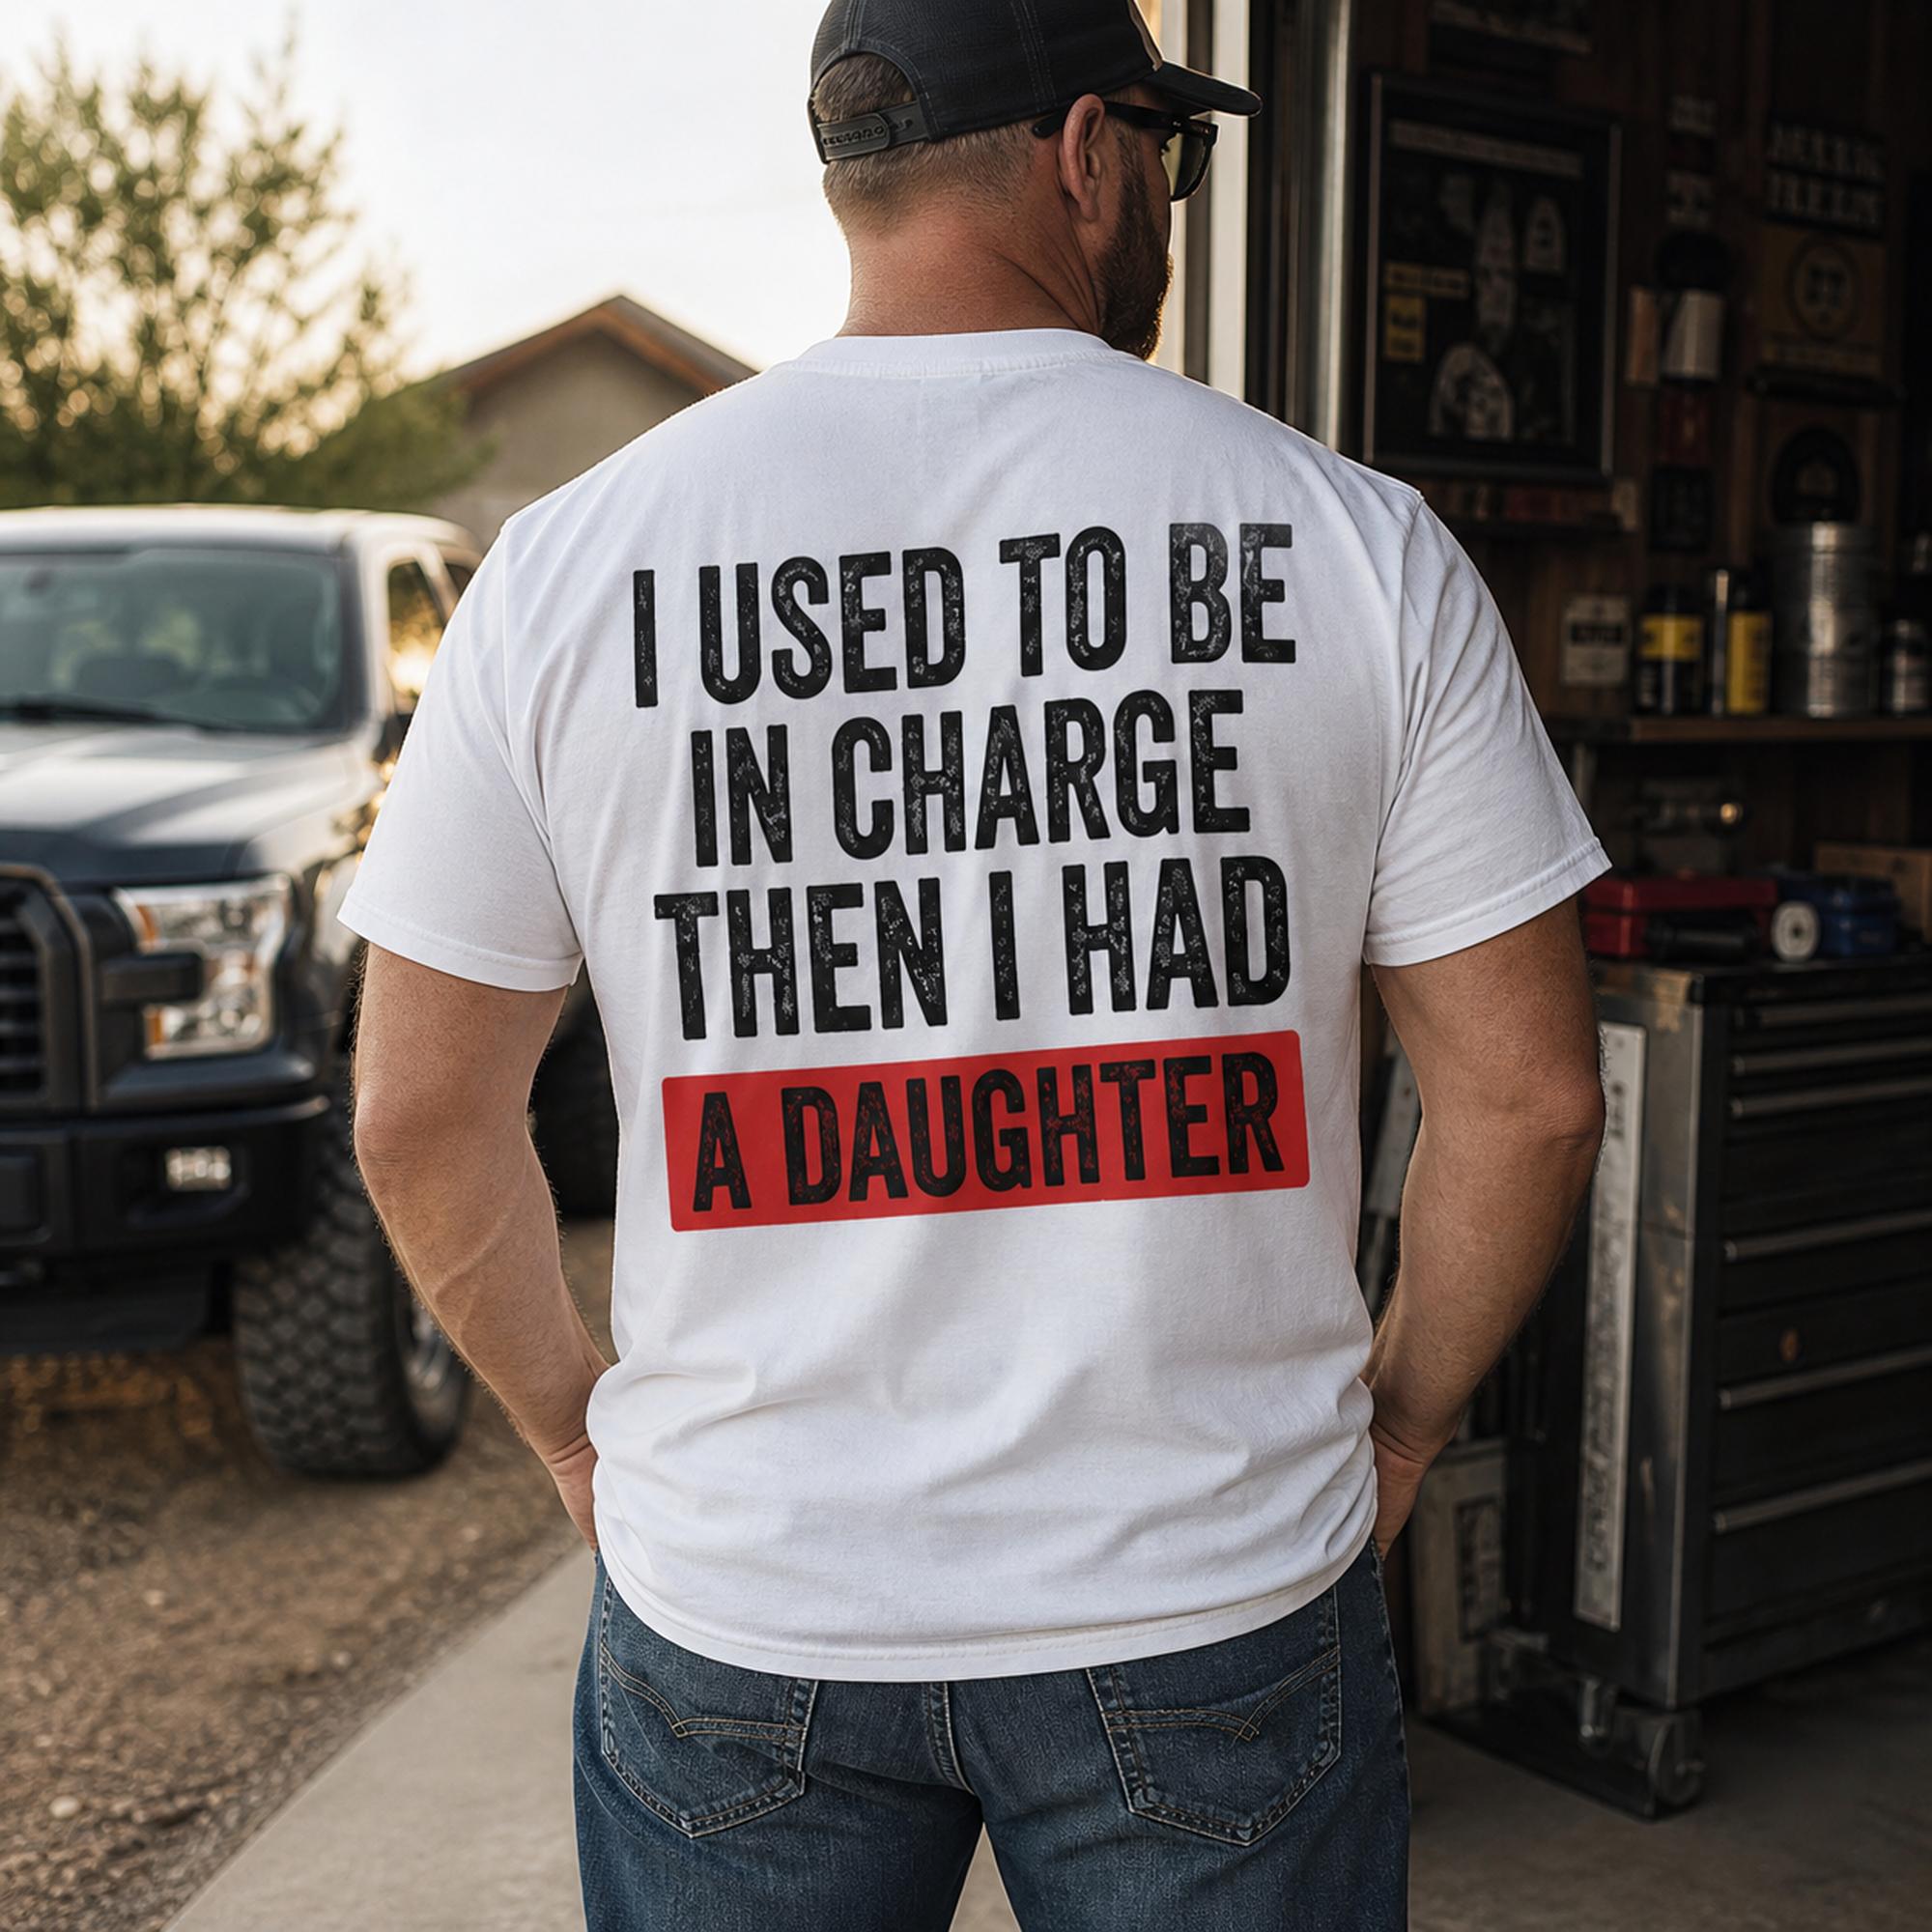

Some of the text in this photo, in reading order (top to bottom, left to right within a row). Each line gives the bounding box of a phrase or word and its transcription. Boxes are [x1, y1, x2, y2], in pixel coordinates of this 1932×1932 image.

[633, 523, 1296, 709] I USED TO BE
[690, 689, 1251, 868] IN CHARGE
[653, 855, 1292, 1041] THEN I HAD
[692, 1050, 1286, 1212] A DAUGHTER
